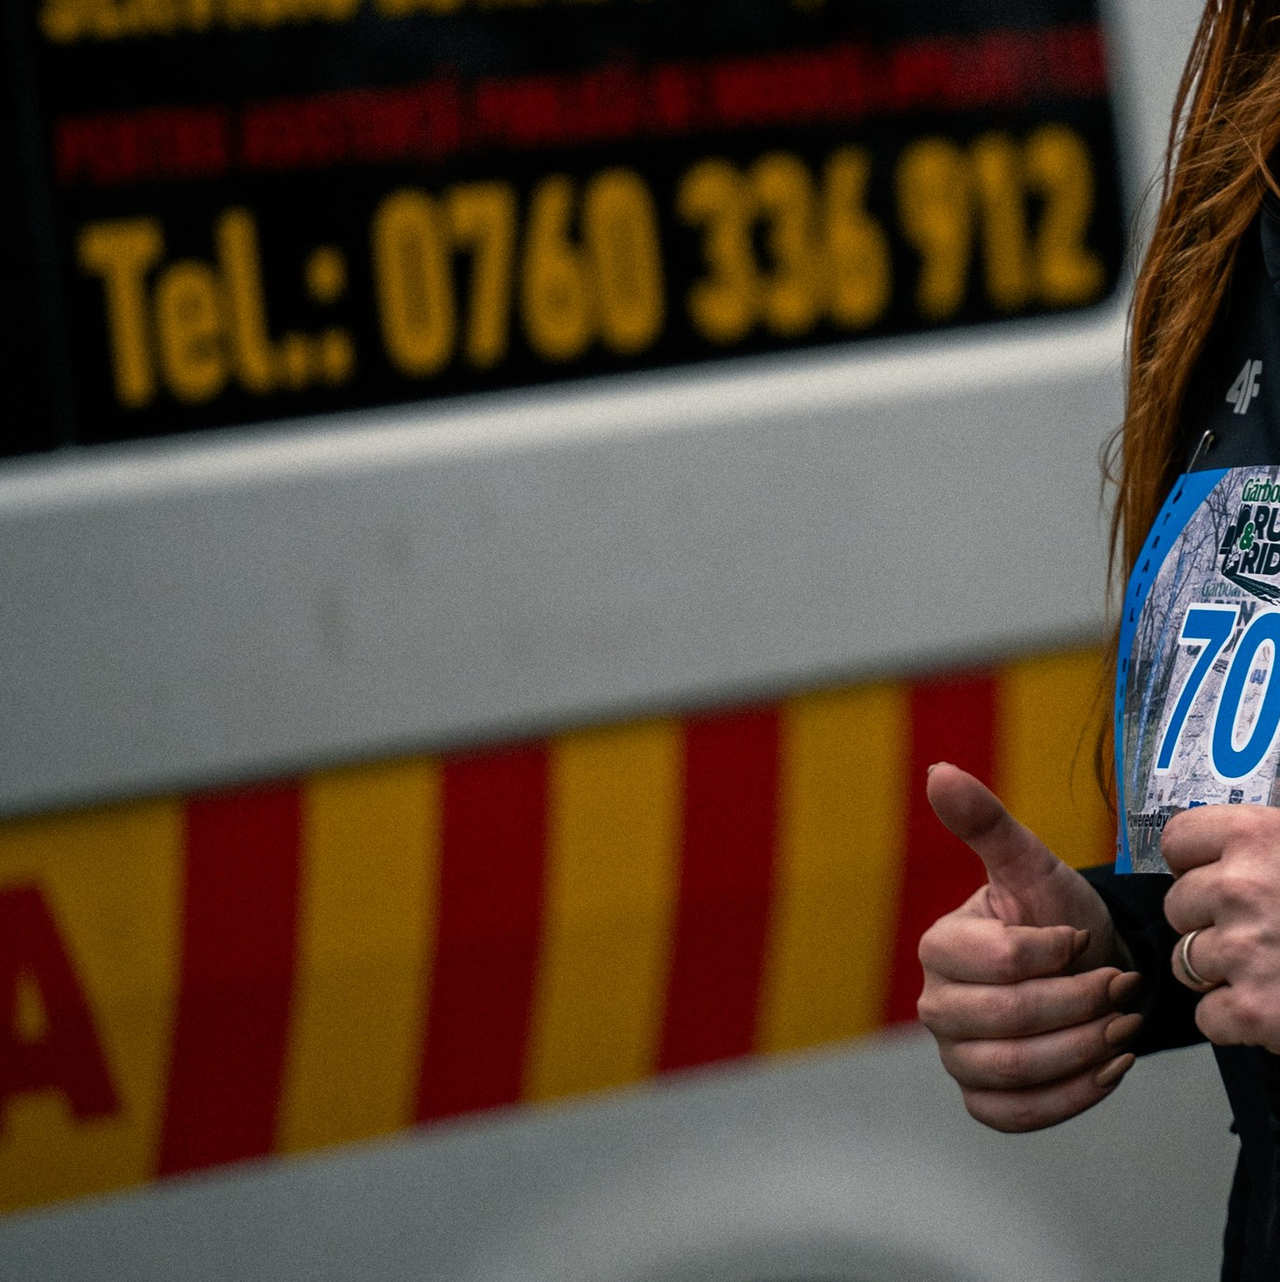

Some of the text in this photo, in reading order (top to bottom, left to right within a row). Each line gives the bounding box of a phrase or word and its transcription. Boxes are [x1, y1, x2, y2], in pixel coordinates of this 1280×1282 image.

[372, 165, 667, 378] 0760
[675, 145, 892, 344] 336
[895, 125, 1105, 317] 912
[1225, 359, 1263, 416] 4F
